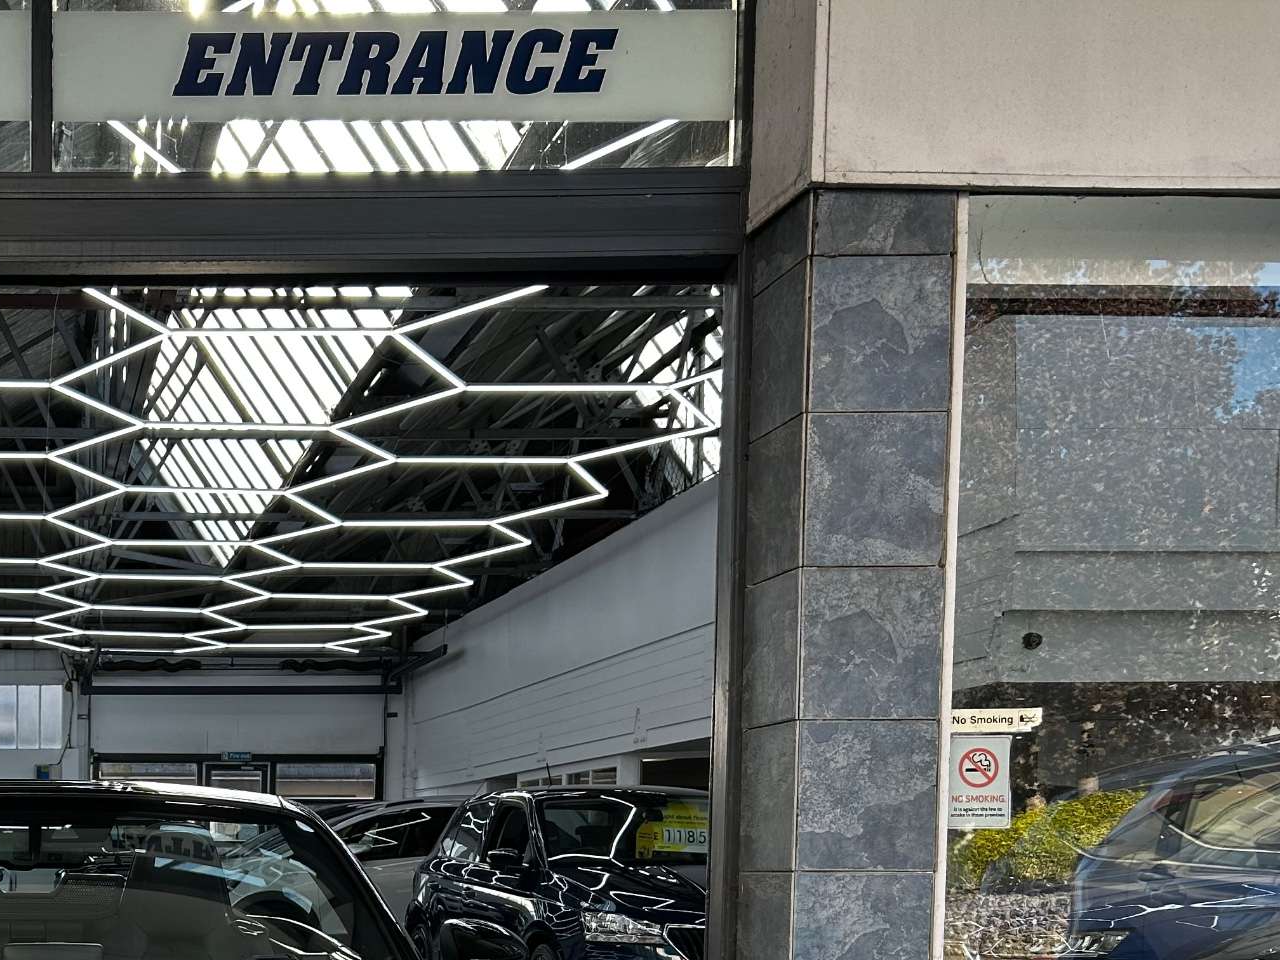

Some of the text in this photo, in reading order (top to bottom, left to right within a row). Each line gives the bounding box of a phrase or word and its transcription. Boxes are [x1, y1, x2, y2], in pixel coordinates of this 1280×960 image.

[172, 28, 619, 97] ENTRANCE
[952, 715, 1013, 726] No Smoking
[951, 794, 1006, 803] NO SMOKING
